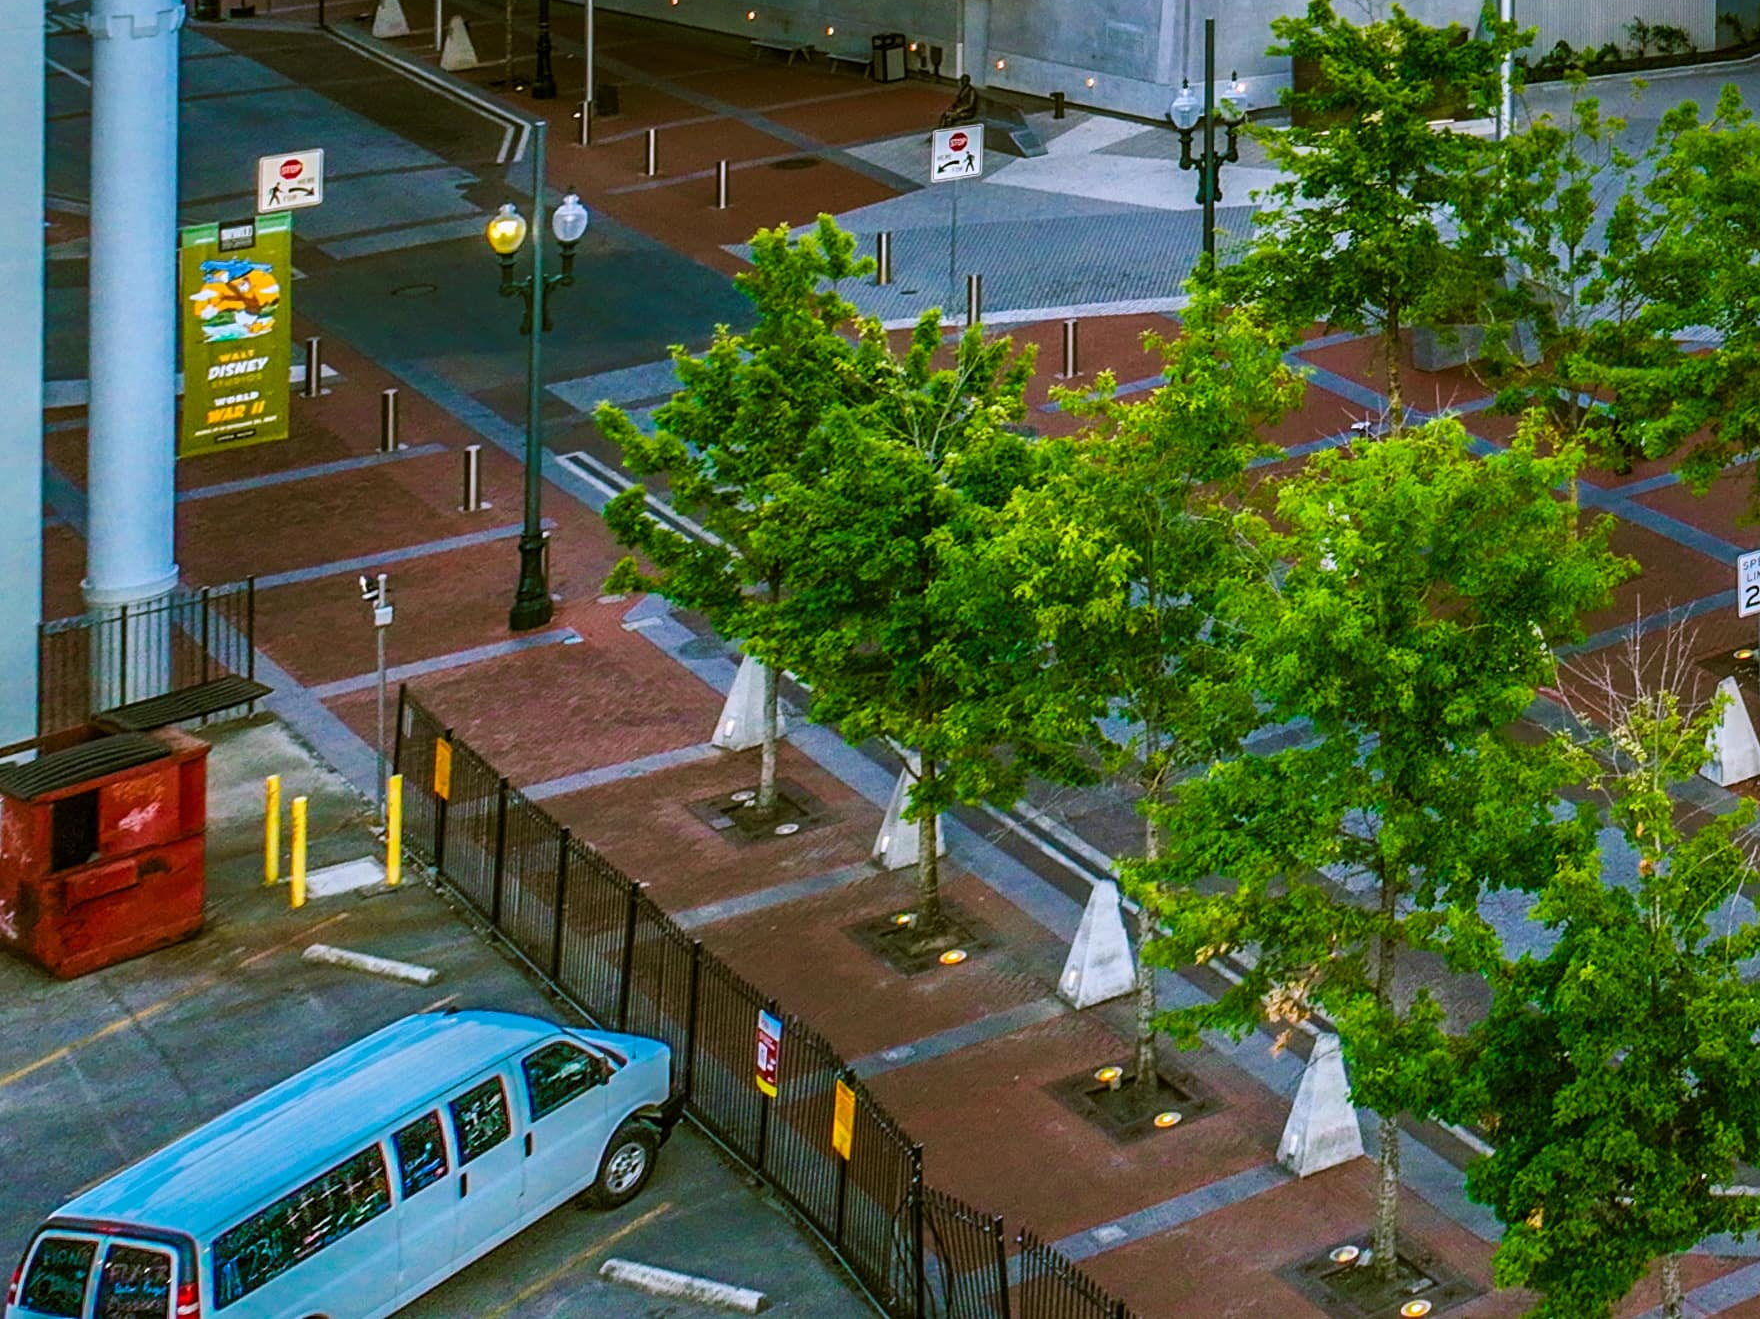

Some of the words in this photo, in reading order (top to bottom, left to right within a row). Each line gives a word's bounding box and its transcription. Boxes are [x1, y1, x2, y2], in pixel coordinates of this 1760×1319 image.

[281, 164, 302, 175] STOP
[218, 349, 255, 363] WALT
[208, 356, 269, 381] DISNEY
[214, 391, 260, 407] WORLD
[207, 403, 247, 424] WAR
